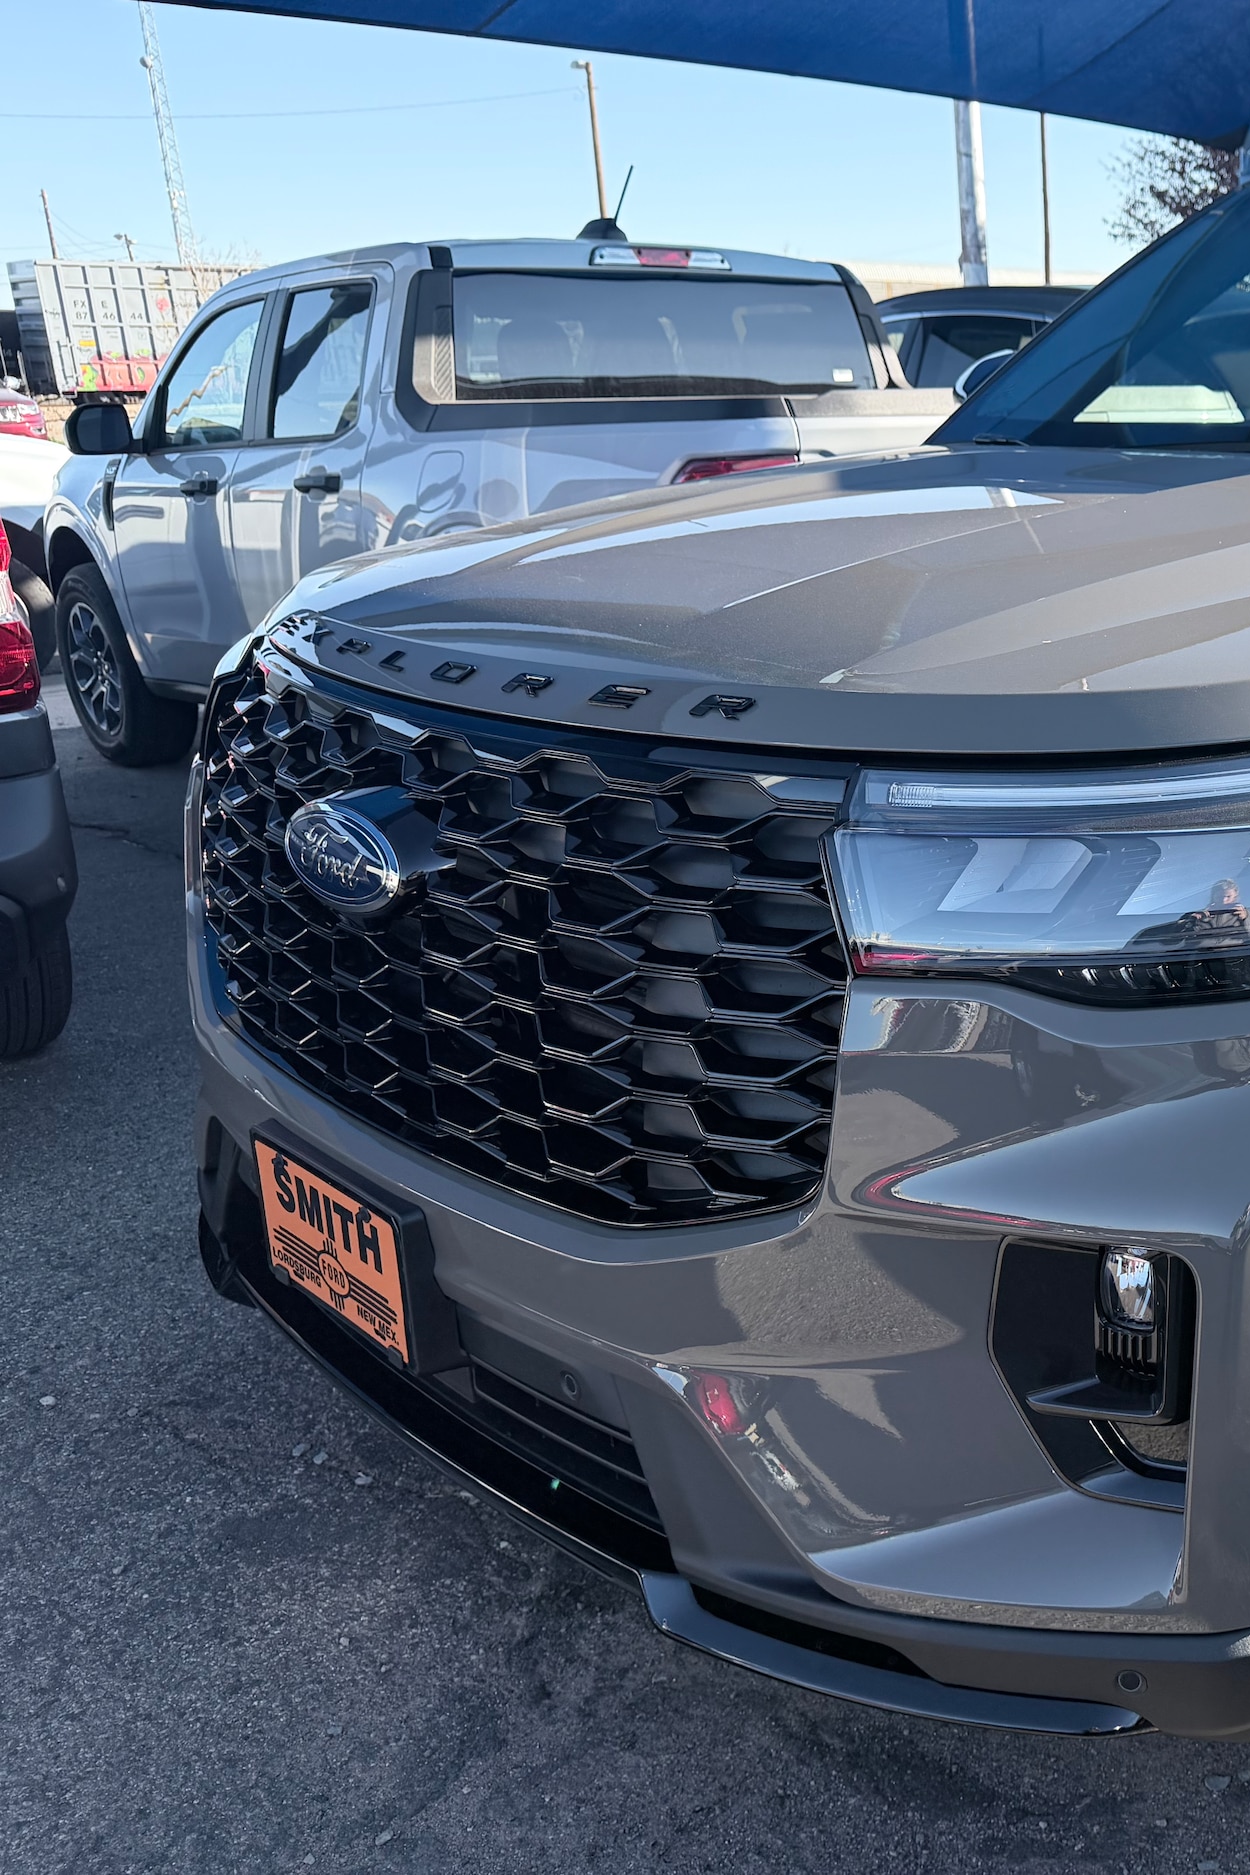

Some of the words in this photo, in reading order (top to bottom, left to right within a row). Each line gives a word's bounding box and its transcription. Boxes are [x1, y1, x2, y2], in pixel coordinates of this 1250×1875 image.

[301, 822, 363, 889] Ford
[272, 1158, 383, 1275] SMITH
[272, 1246, 322, 1289] LORDSBURG
[320, 1258, 347, 1290] FORD
[356, 1304, 376, 1327] NEW
[377, 1319, 400, 1346] MEX.
